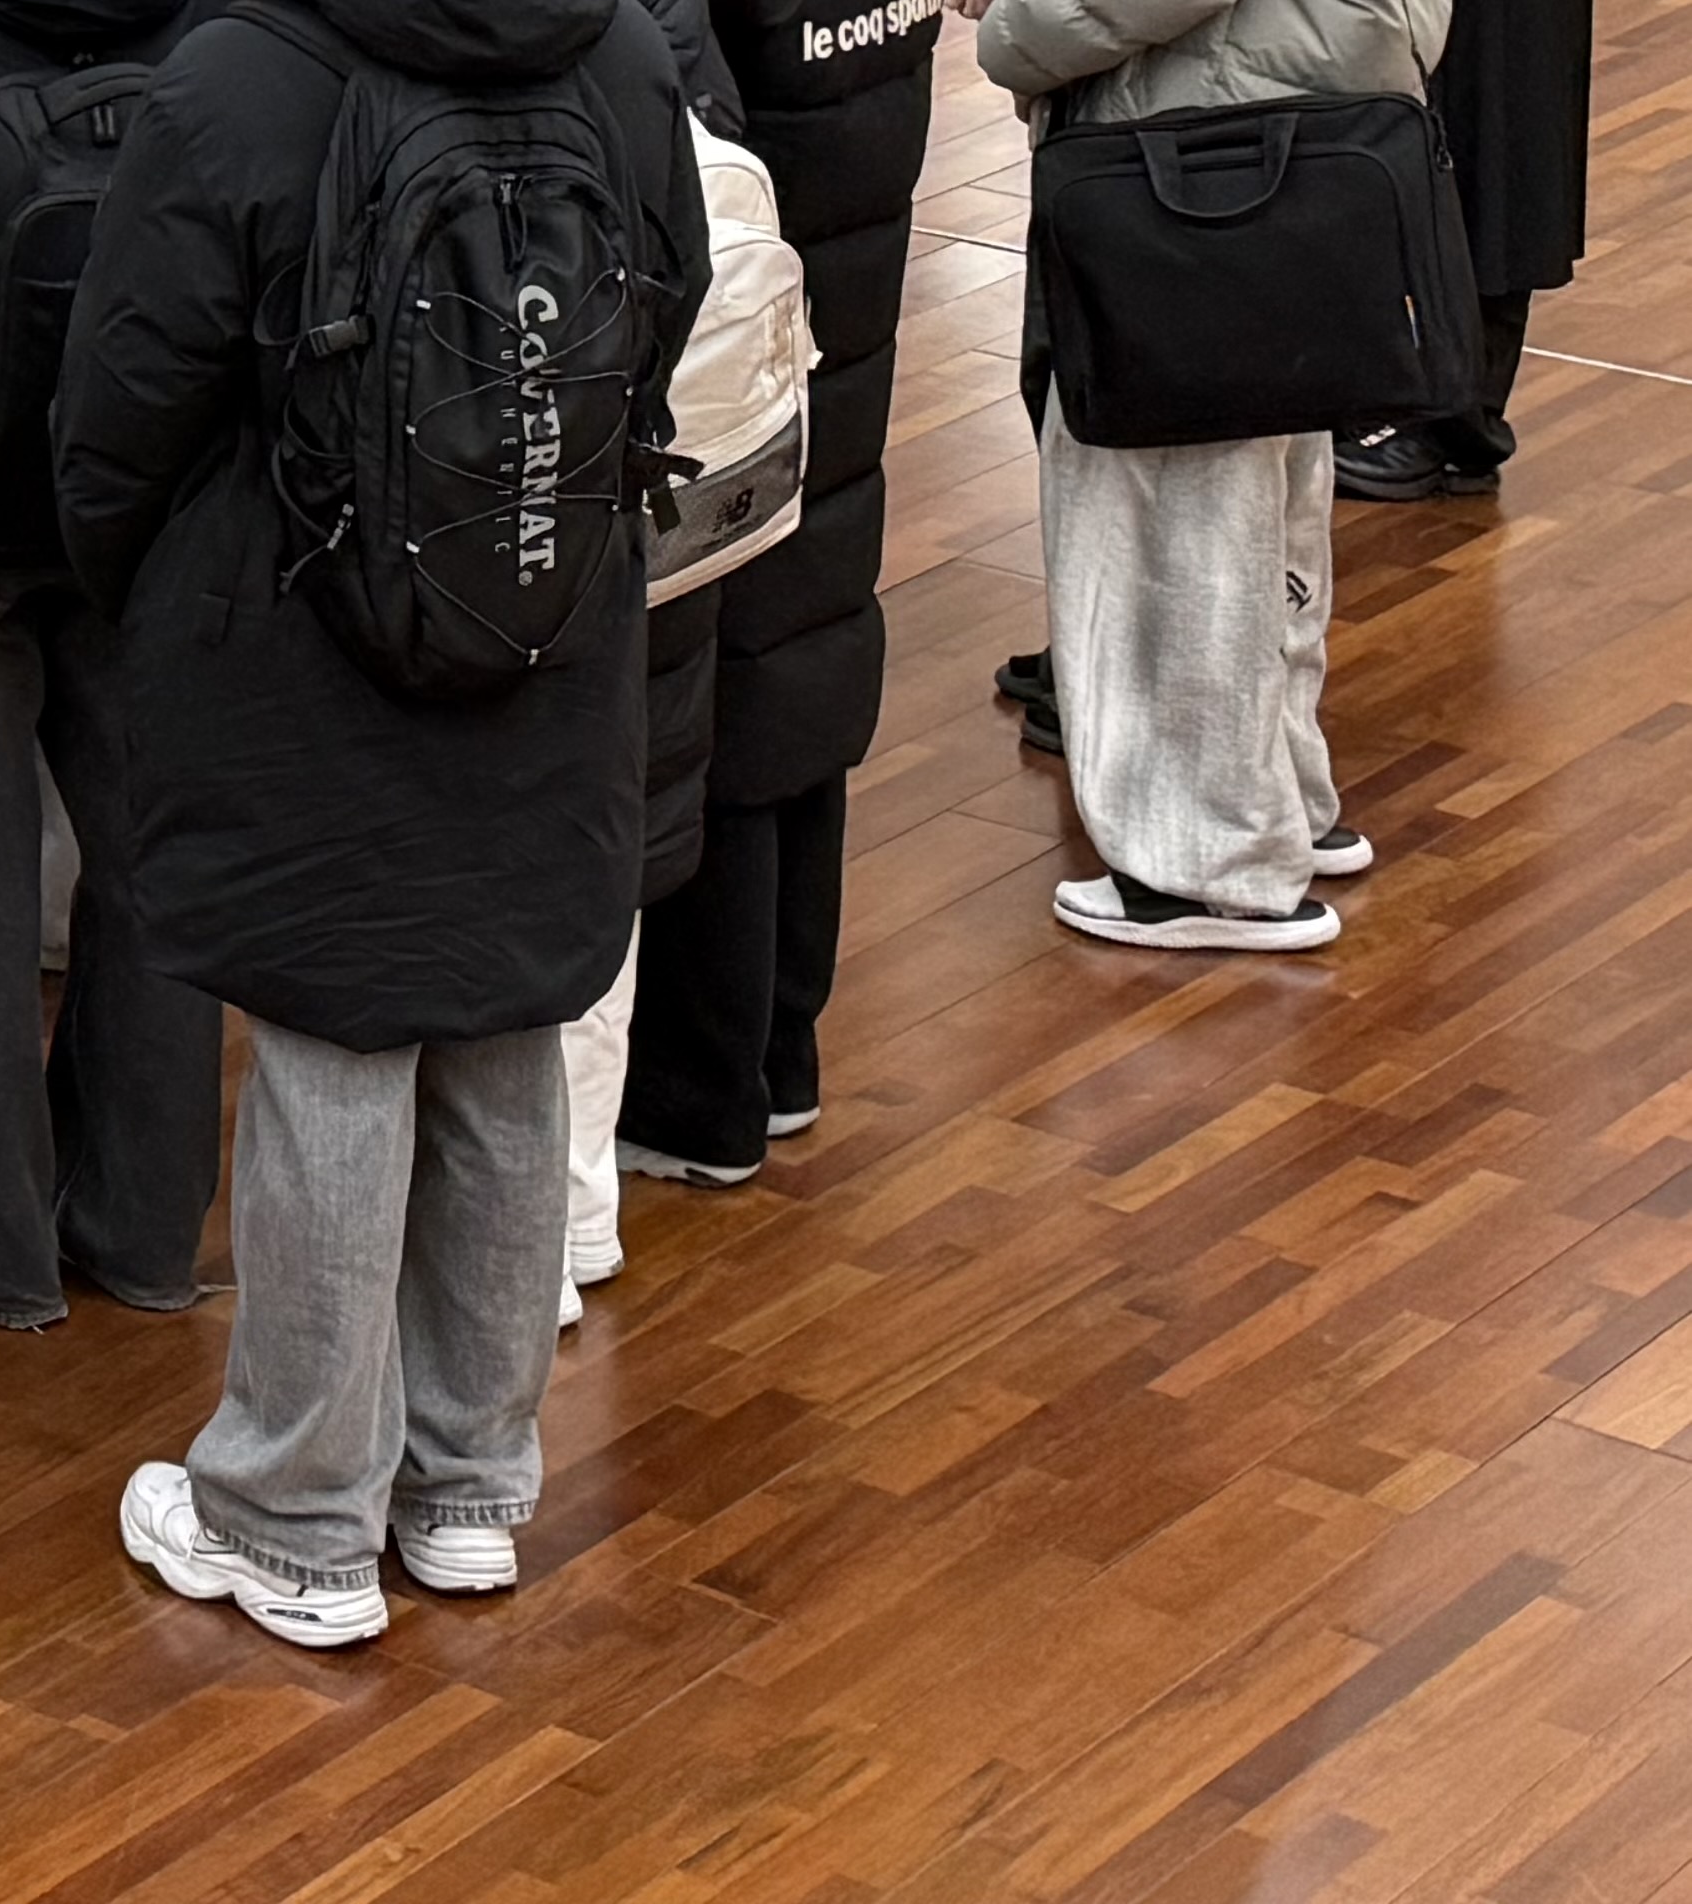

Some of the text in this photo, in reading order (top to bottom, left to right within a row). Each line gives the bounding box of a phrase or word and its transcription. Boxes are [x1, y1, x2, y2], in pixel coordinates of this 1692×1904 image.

[803, 20, 834, 62] le
[838, 6, 884, 46] coq
[517, 284, 561, 571] COVERNAT
